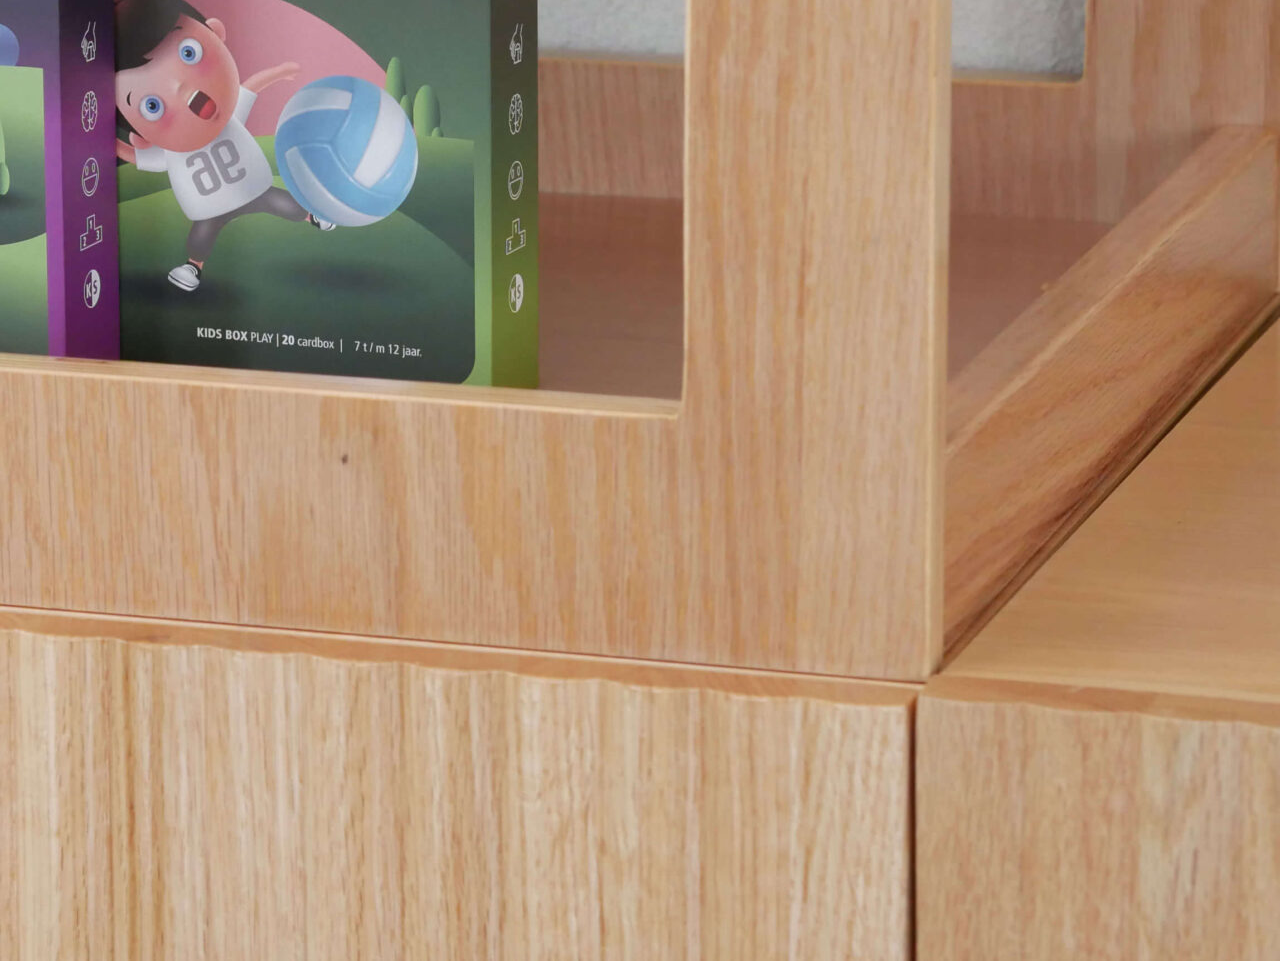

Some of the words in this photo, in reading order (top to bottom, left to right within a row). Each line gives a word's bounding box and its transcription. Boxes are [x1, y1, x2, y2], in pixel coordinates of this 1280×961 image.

[196, 326, 223, 339] KIDS
[225, 329, 248, 342] BOX
[250, 331, 274, 344] PLAY
[282, 334, 295, 346] 20
[297, 336, 335, 350] cardbox
[354, 341, 360, 352] 7
[388, 343, 400, 356] 12
[402, 345, 422, 359] jaar.
